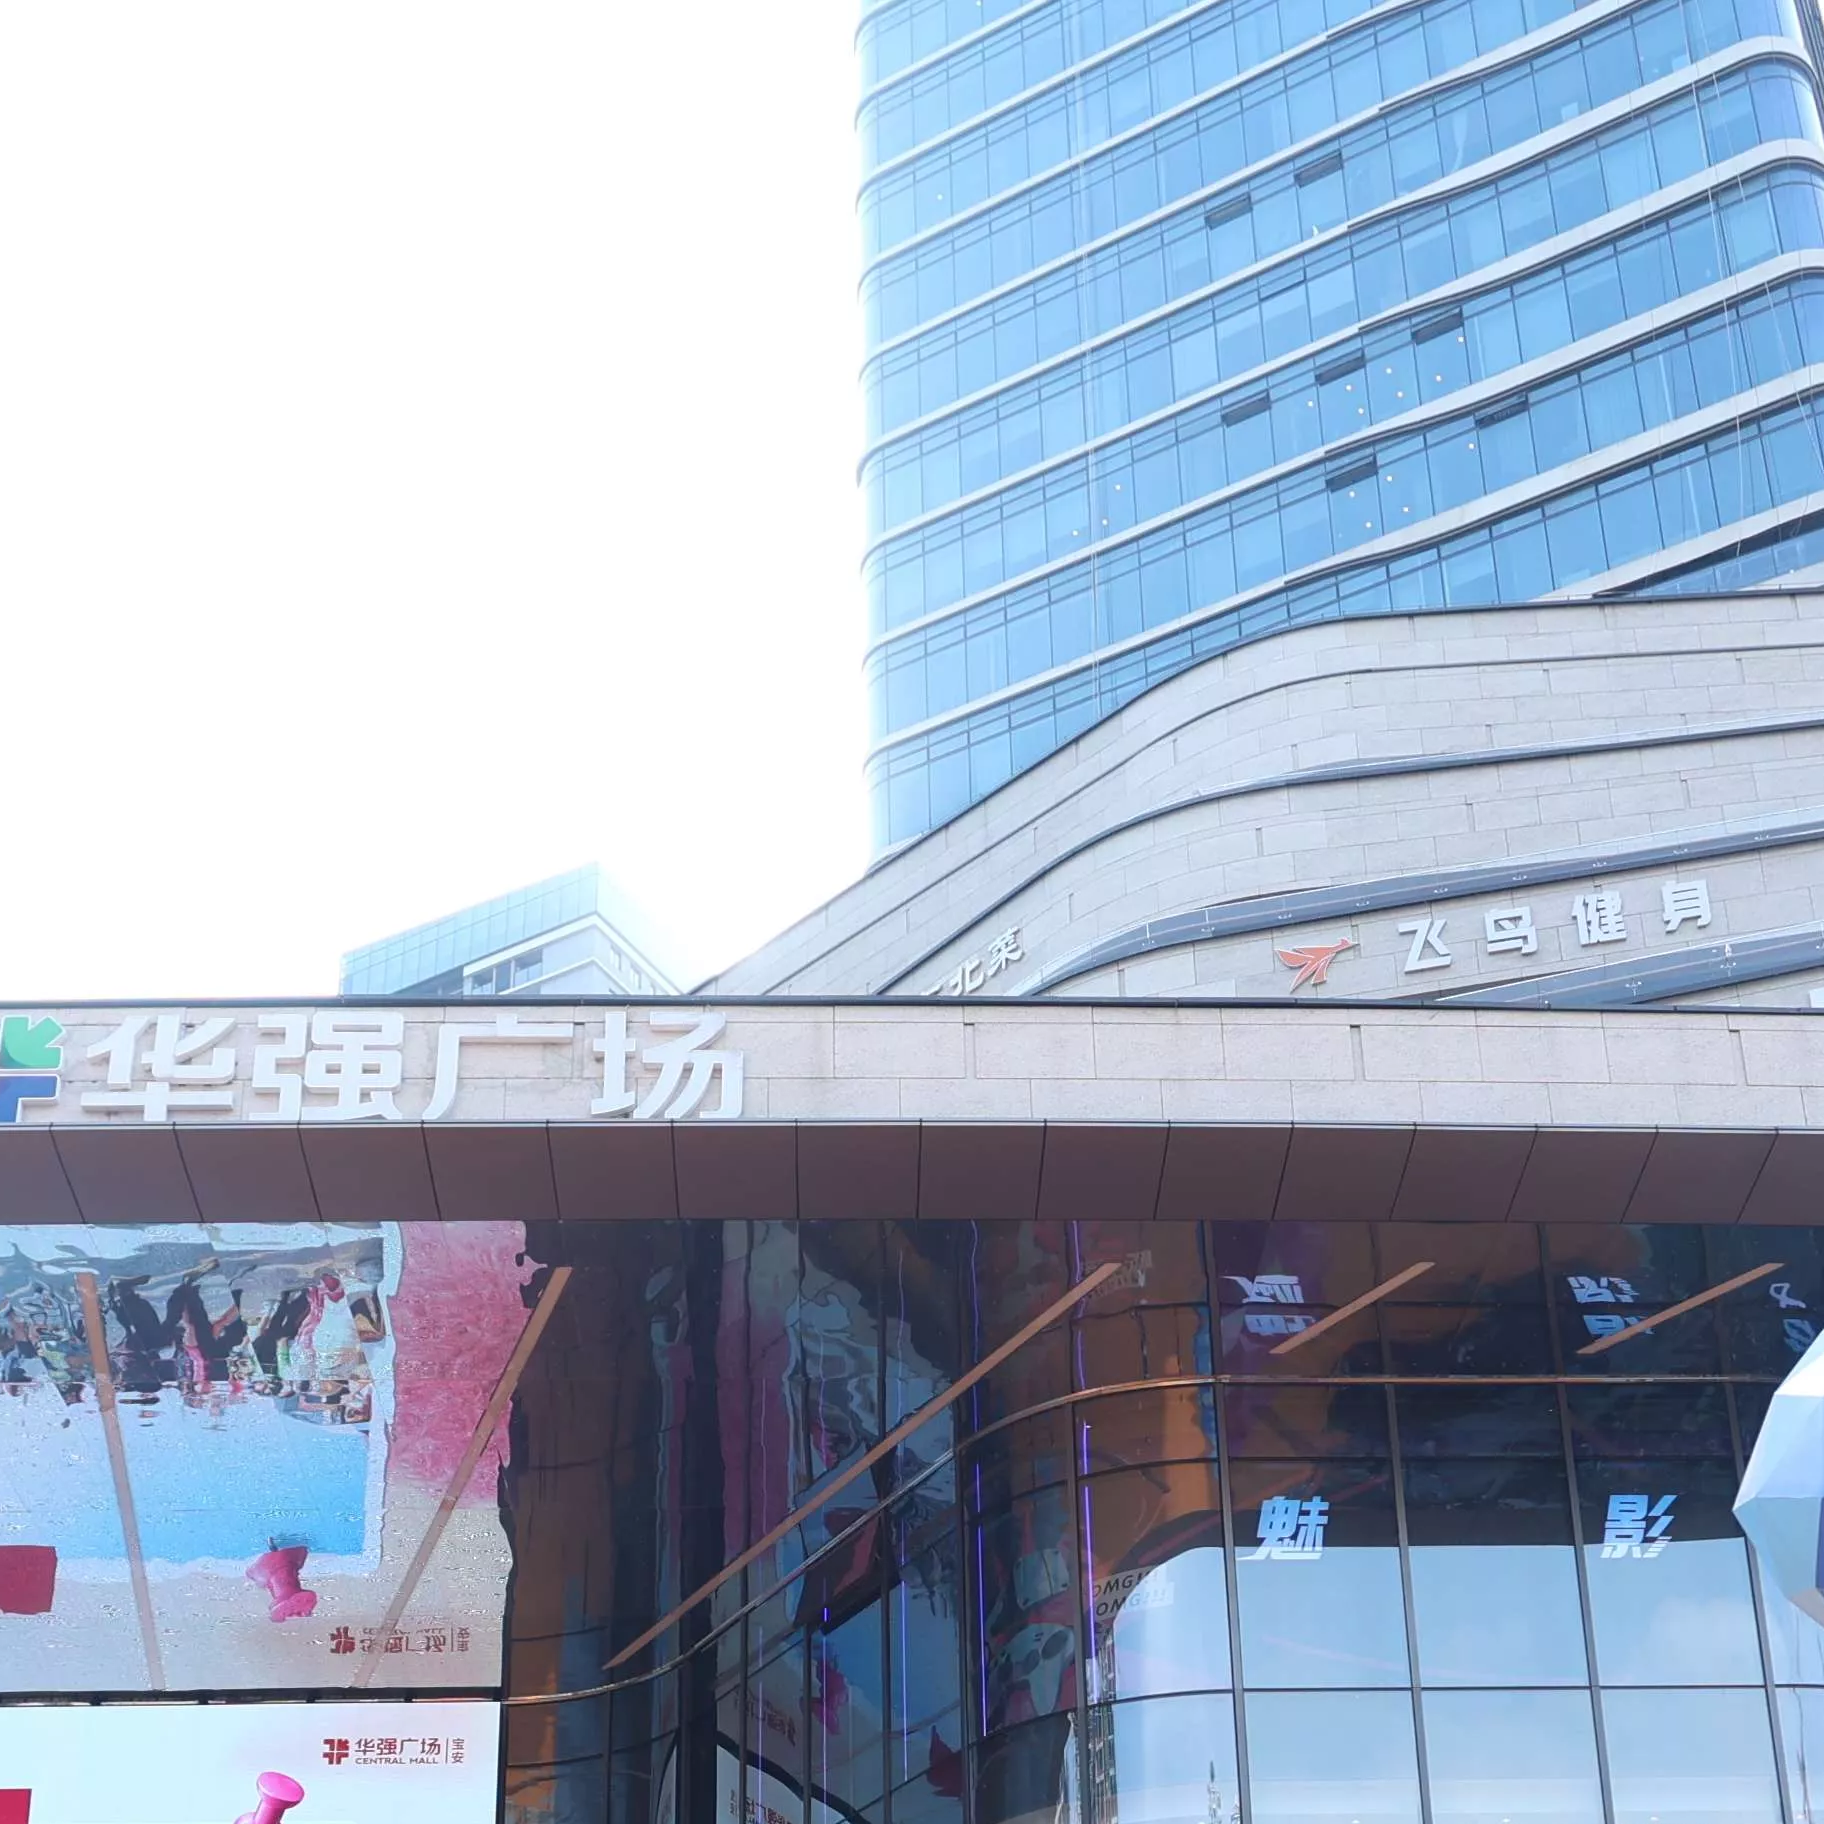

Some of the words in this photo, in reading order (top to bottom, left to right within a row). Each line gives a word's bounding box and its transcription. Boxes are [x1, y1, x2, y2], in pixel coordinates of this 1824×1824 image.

[920, 926, 1026, 997] 北菜
[1397, 879, 1713, 974] 飞鸟健身
[80, 1010, 744, 1123] 华强广场
[355, 1737, 441, 1756] 华强广场
[452, 1738, 465, 1764] 宝安
[355, 1757, 405, 1765] CENTRAL
[409, 1757, 439, 1765] MALL
